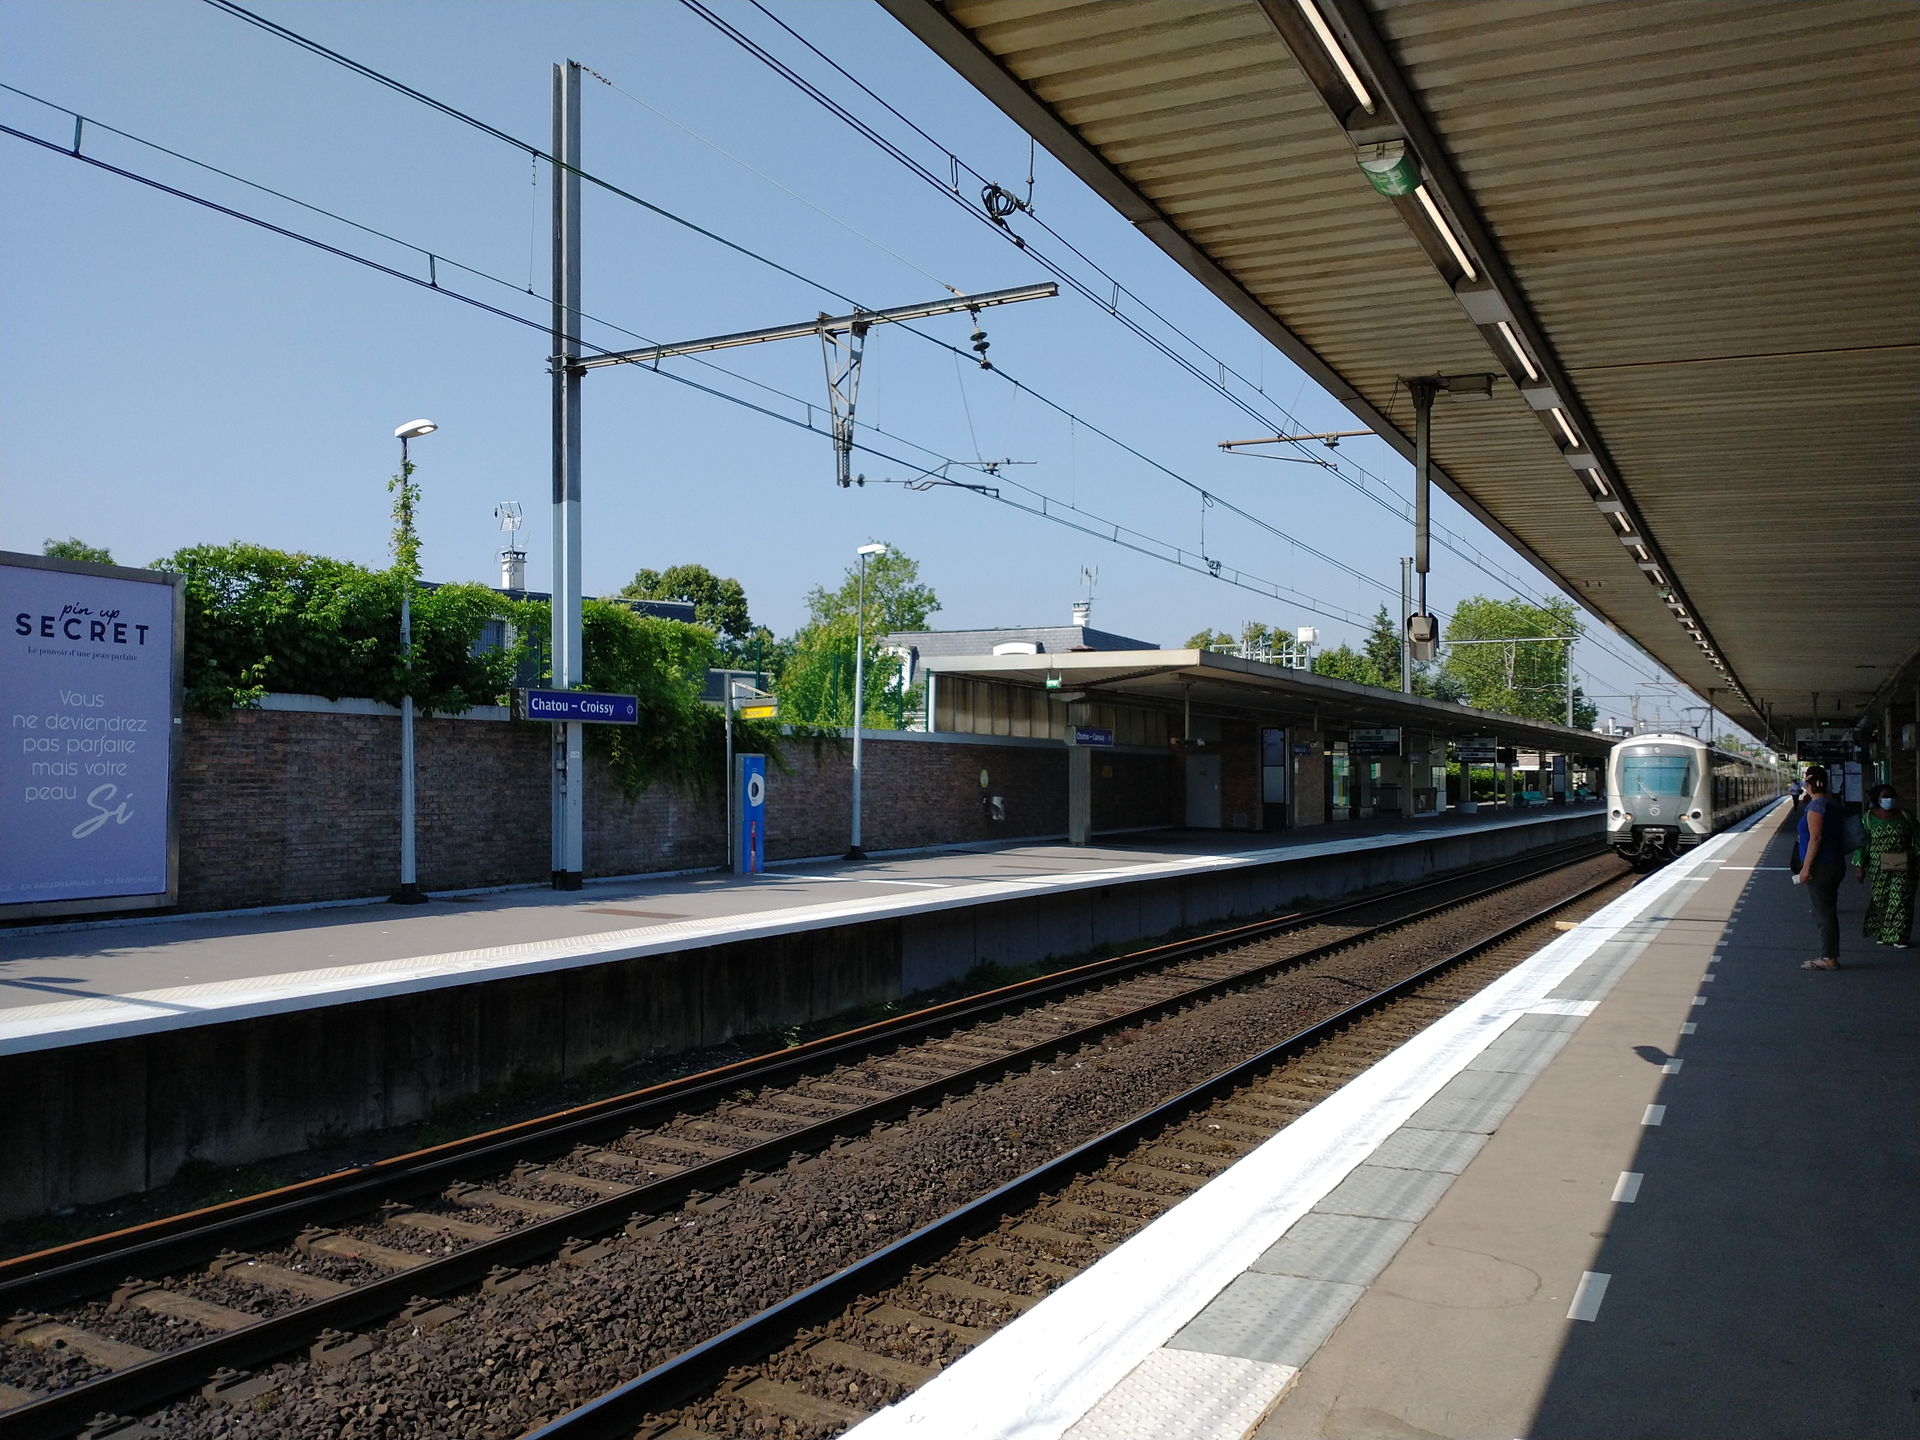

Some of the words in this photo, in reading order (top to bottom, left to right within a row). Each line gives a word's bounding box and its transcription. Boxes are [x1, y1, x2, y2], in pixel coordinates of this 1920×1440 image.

[59, 602, 93, 621] pin
[99, 609, 120, 625] up
[15, 612, 149, 645] SECRET
[59, 689, 104, 707] Vous
[531, 698, 569, 712] Chatou
[580, 700, 614, 716] Croissy
[12, 714, 37, 728] ne
[45, 713, 147, 732] deviendrez
[23, 737, 60, 754] pas
[66, 735, 136, 757] parfaite
[32, 759, 78, 776] mais
[84, 760, 128, 776] votre
[25, 785, 77, 802] peau
[72, 783, 134, 839] Si
